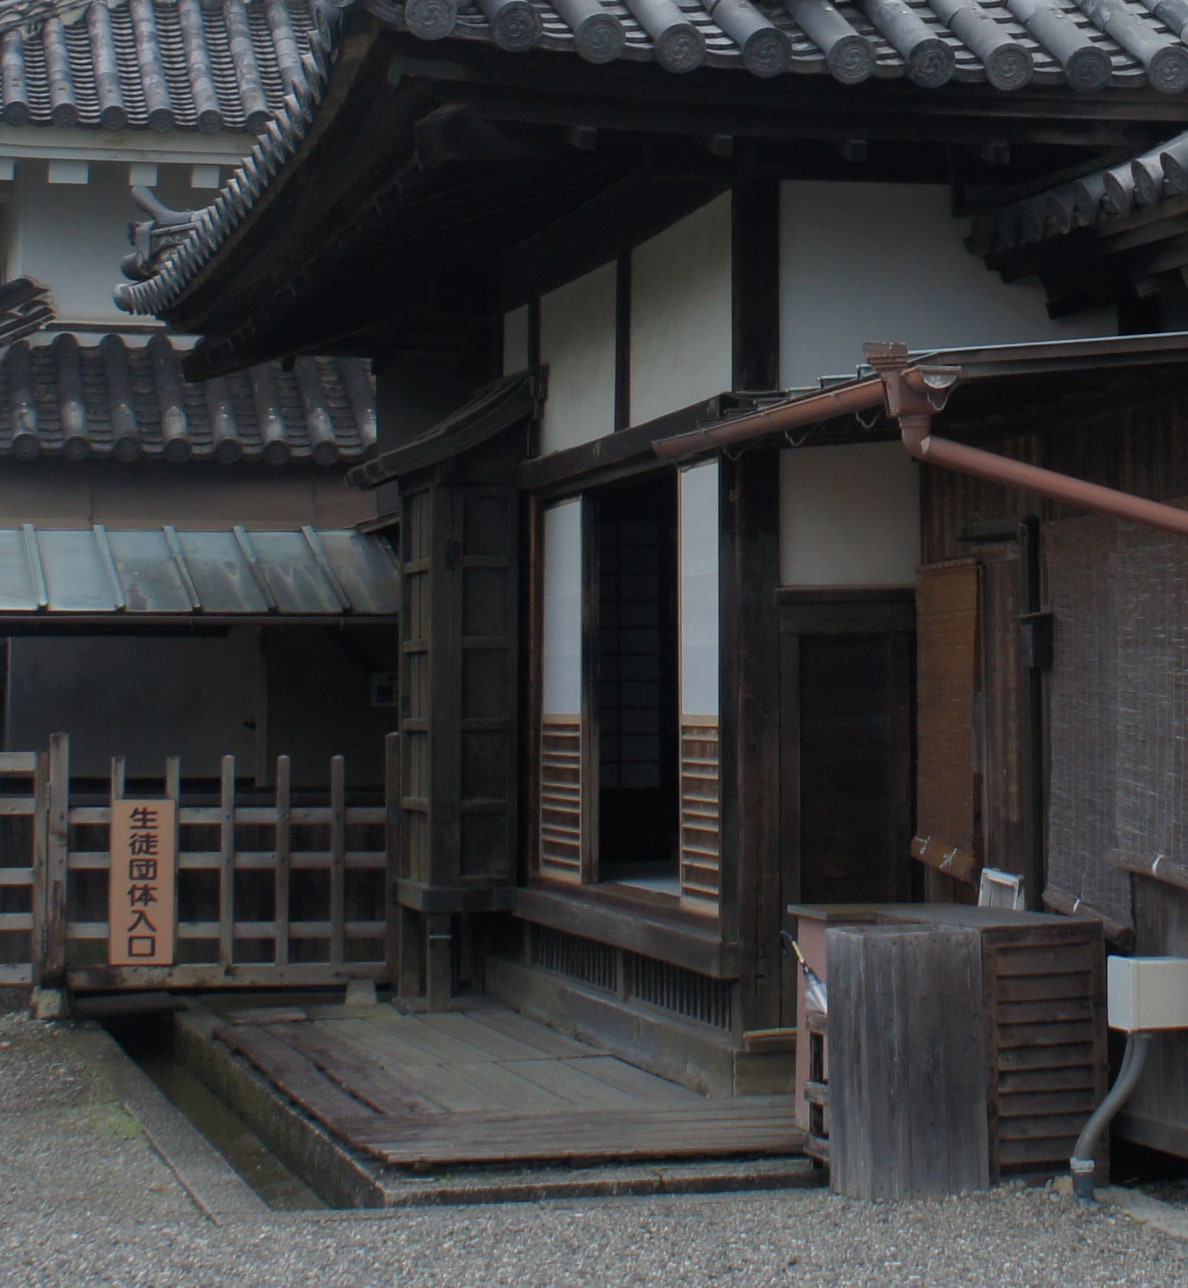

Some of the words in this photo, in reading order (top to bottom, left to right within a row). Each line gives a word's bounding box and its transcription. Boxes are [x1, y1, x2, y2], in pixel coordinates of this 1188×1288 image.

[127, 807, 159, 957] 生徒団体入口
